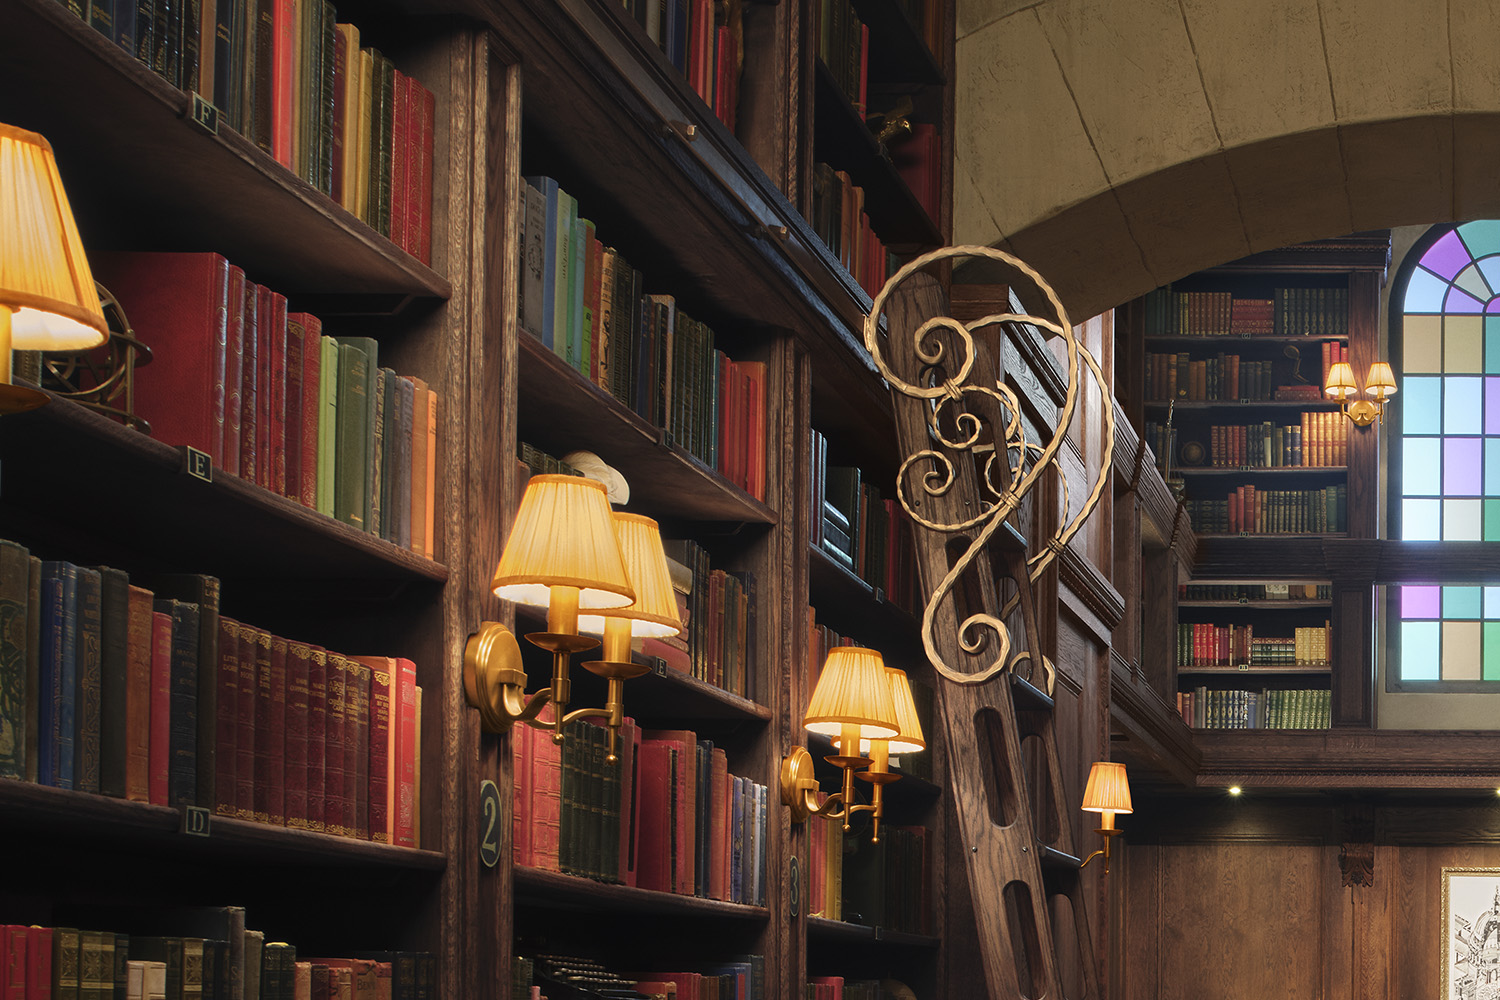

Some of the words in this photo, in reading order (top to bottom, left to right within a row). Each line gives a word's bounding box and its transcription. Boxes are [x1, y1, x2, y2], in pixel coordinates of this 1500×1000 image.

[199, 100, 212, 125] F
[194, 452, 206, 477] E
[192, 811, 204, 832] D
[481, 796, 498, 854] 2
[790, 867, 799, 905] 3
